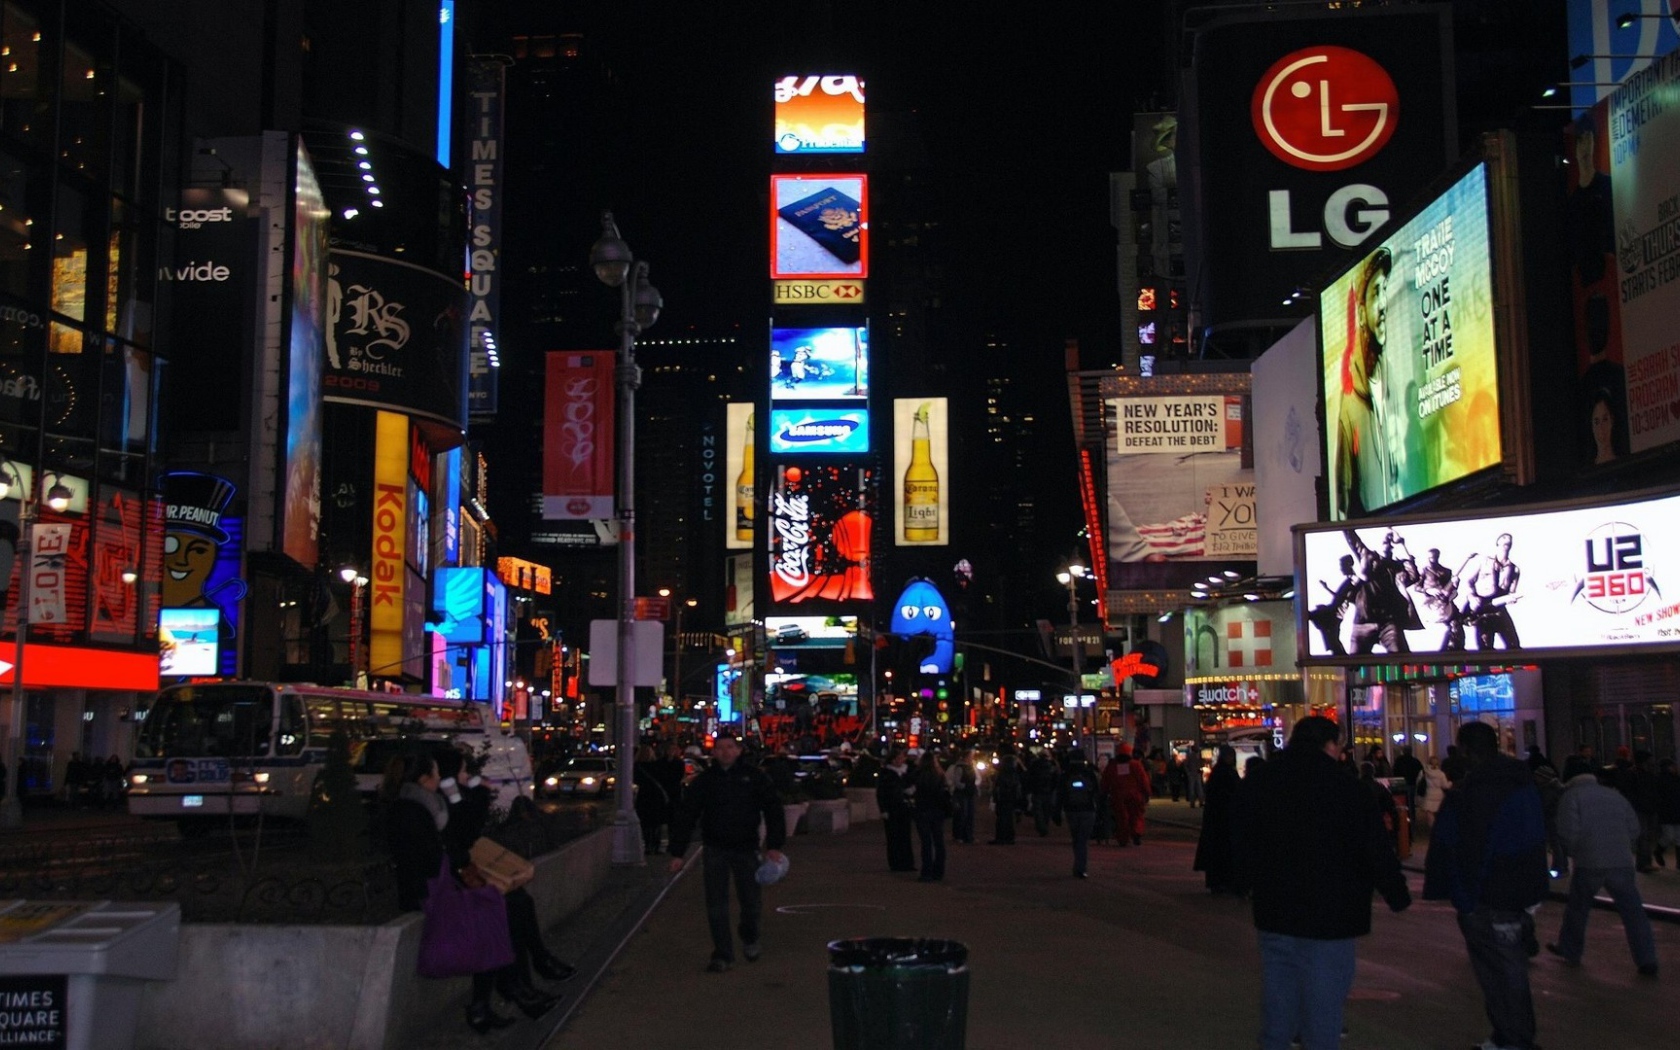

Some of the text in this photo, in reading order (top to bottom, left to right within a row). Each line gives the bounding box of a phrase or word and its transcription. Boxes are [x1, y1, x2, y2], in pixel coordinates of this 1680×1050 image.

[471, 90, 497, 211] TIMES
[1269, 183, 1390, 250] LG
[1414, 216, 1453, 262] TRAVIE
[1415, 240, 1455, 290] MCCOY
[1658, 253, 1680, 285] FEBR
[469, 224, 496, 375] SQUARE
[775, 284, 831, 299] HSBC
[1422, 277, 1450, 318] ONE
[1423, 309, 1451, 346] AT A
[1423, 334, 1454, 370] TIME
[1124, 403, 1218, 418] NEW YEAR'S
[1418, 400, 1432, 418] ON
[1124, 419, 1219, 434] RESOLUTION:
[1125, 435, 1217, 447] DEFEAT THE DEBT
[702, 435, 716, 521] NOVOTEL
[1222, 487, 1230, 498] I
[179, 505, 219, 526] PEANUT
[907, 505, 936, 519] Light
[374, 482, 405, 607] Kodak
[1211, 532, 1256, 549] TO GIVE
[1585, 534, 1643, 573] U2
[1635, 613, 1653, 626] NEW
[0, 1010, 60, 1029] QUARE
[0, 1030, 56, 1042] LLIANCE
